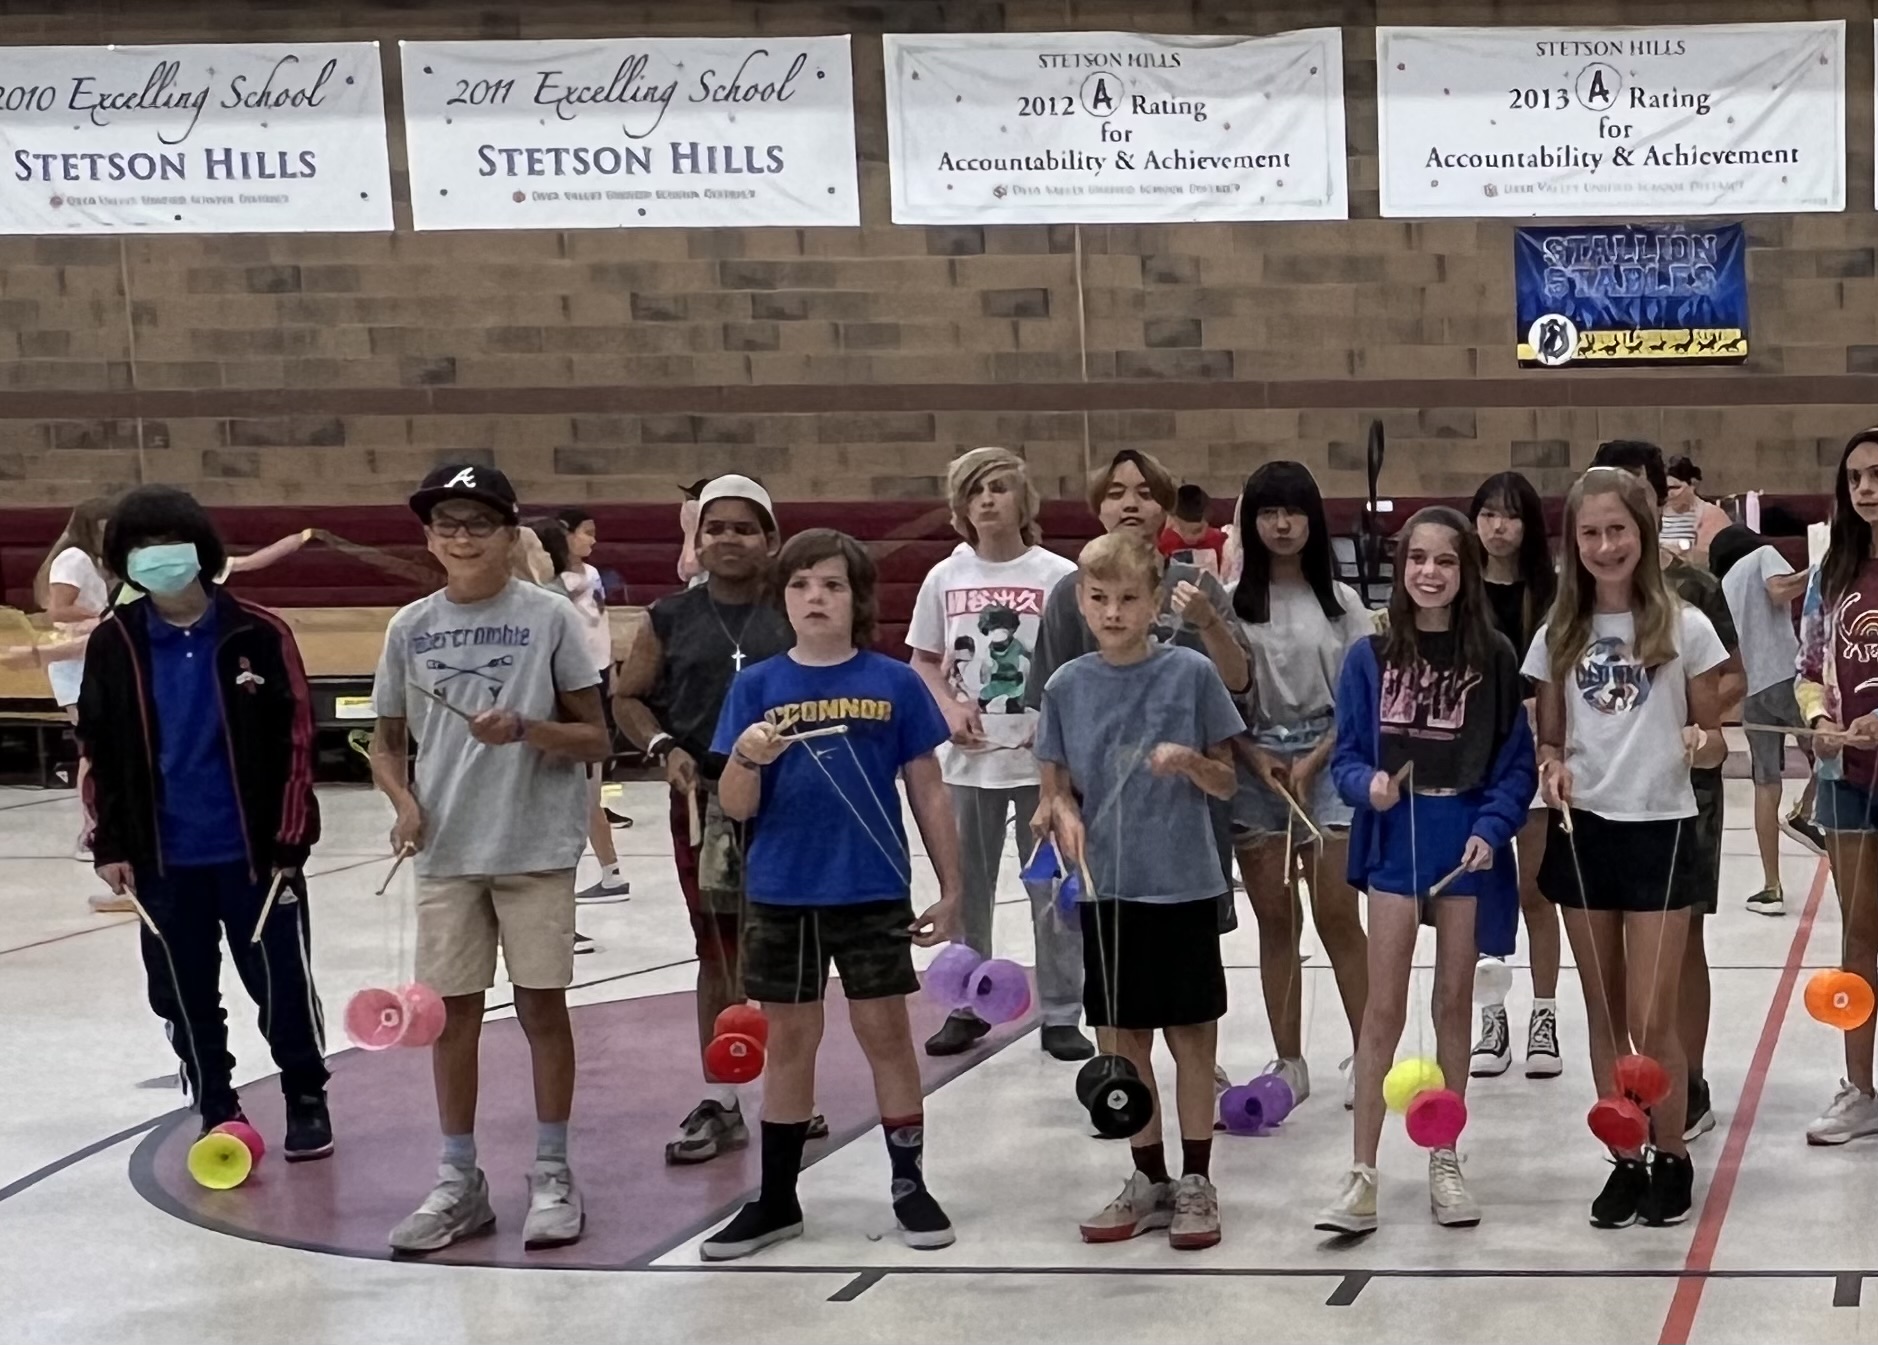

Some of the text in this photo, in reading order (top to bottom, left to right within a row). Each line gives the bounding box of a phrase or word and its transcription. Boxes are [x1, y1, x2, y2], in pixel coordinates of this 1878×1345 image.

[1038, 52, 1122, 69] STETSON
[1536, 39, 1686, 57] STETSON HILLS
[68, 60, 210, 145] Excelling
[220, 54, 338, 109] School
[446, 48, 808, 140] 2011 Excelling School
[1018, 77, 1208, 122] 2012 A Rating
[1509, 68, 1711, 116] 2013 A Rating
[1100, 122, 1134, 143] for
[1599, 115, 1634, 139] for
[14, 147, 318, 182] STETSON HILLS
[477, 141, 785, 177] STETSON HILLS
[938, 150, 1291, 177] Accountability & Achievement
[1425, 144, 1800, 174] Accountability & Achievement
[443, 466, 477, 489] A
